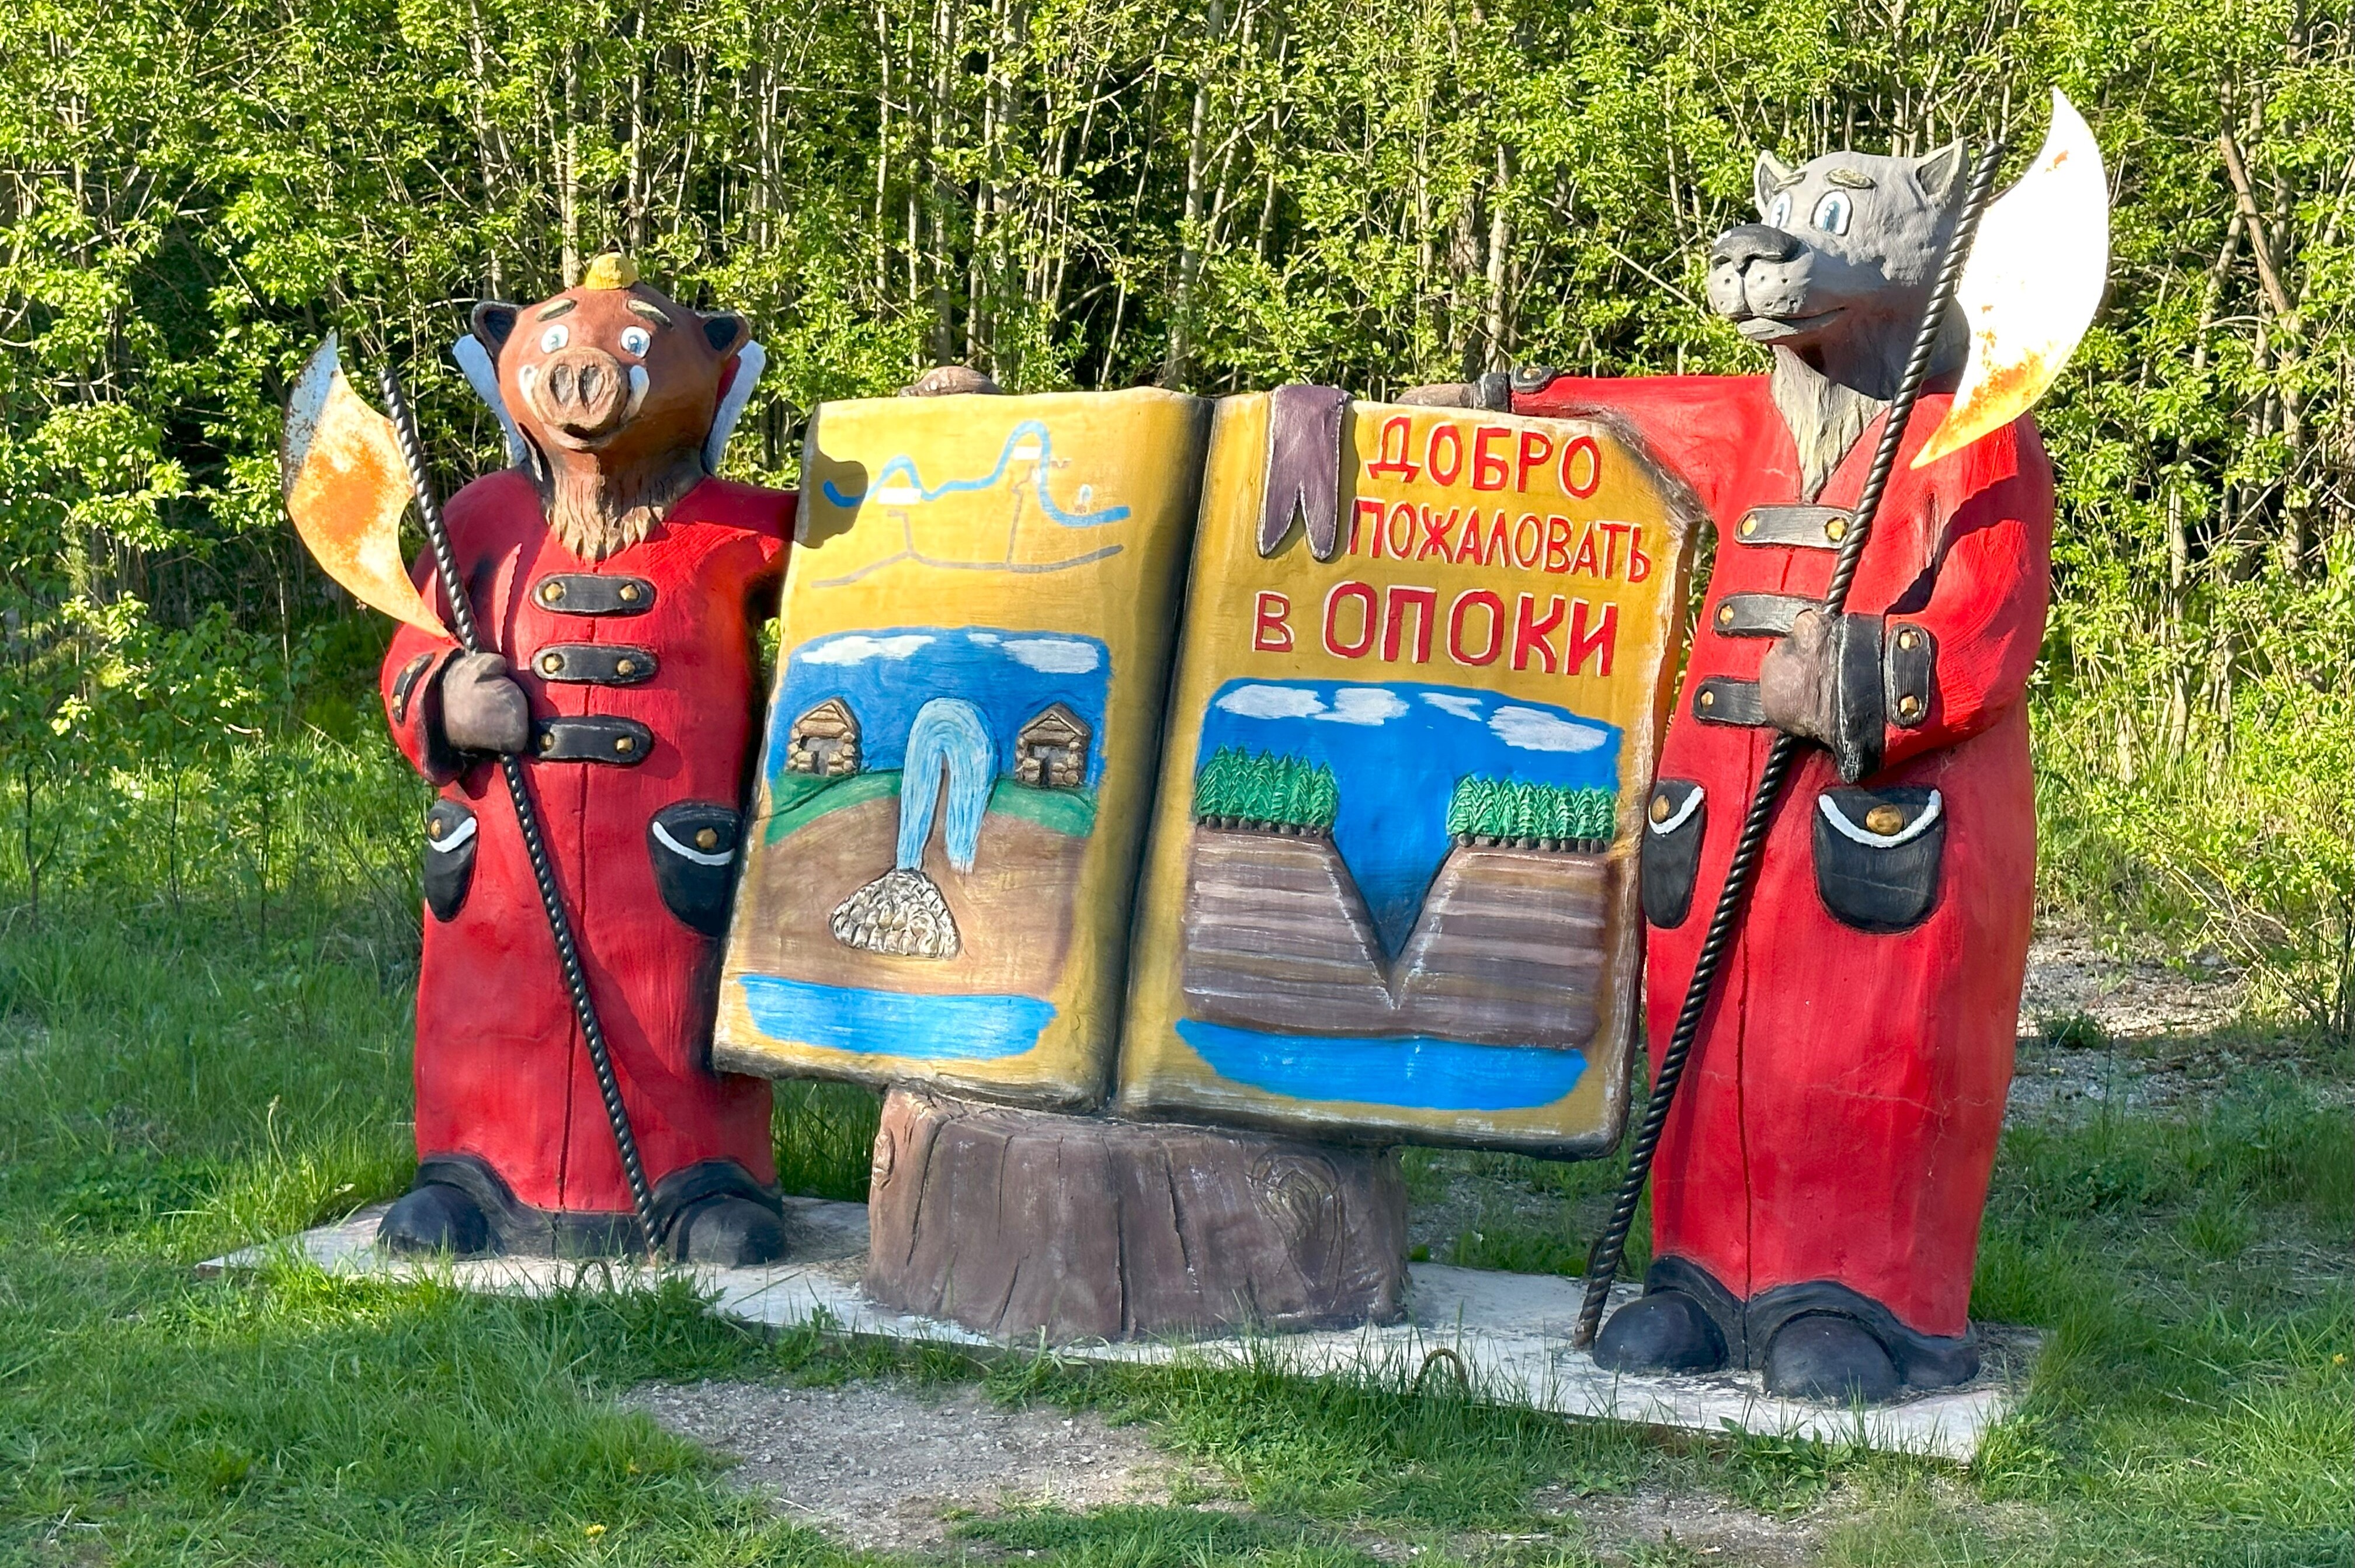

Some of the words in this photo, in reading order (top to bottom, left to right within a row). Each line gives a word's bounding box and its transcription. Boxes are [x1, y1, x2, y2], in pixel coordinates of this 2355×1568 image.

[1367, 415, 1601, 499] ДОБРО
[1349, 498, 1651, 583] ПОЖАЛОВАТЬ
[1323, 581, 1618, 676] ОПОКИ
